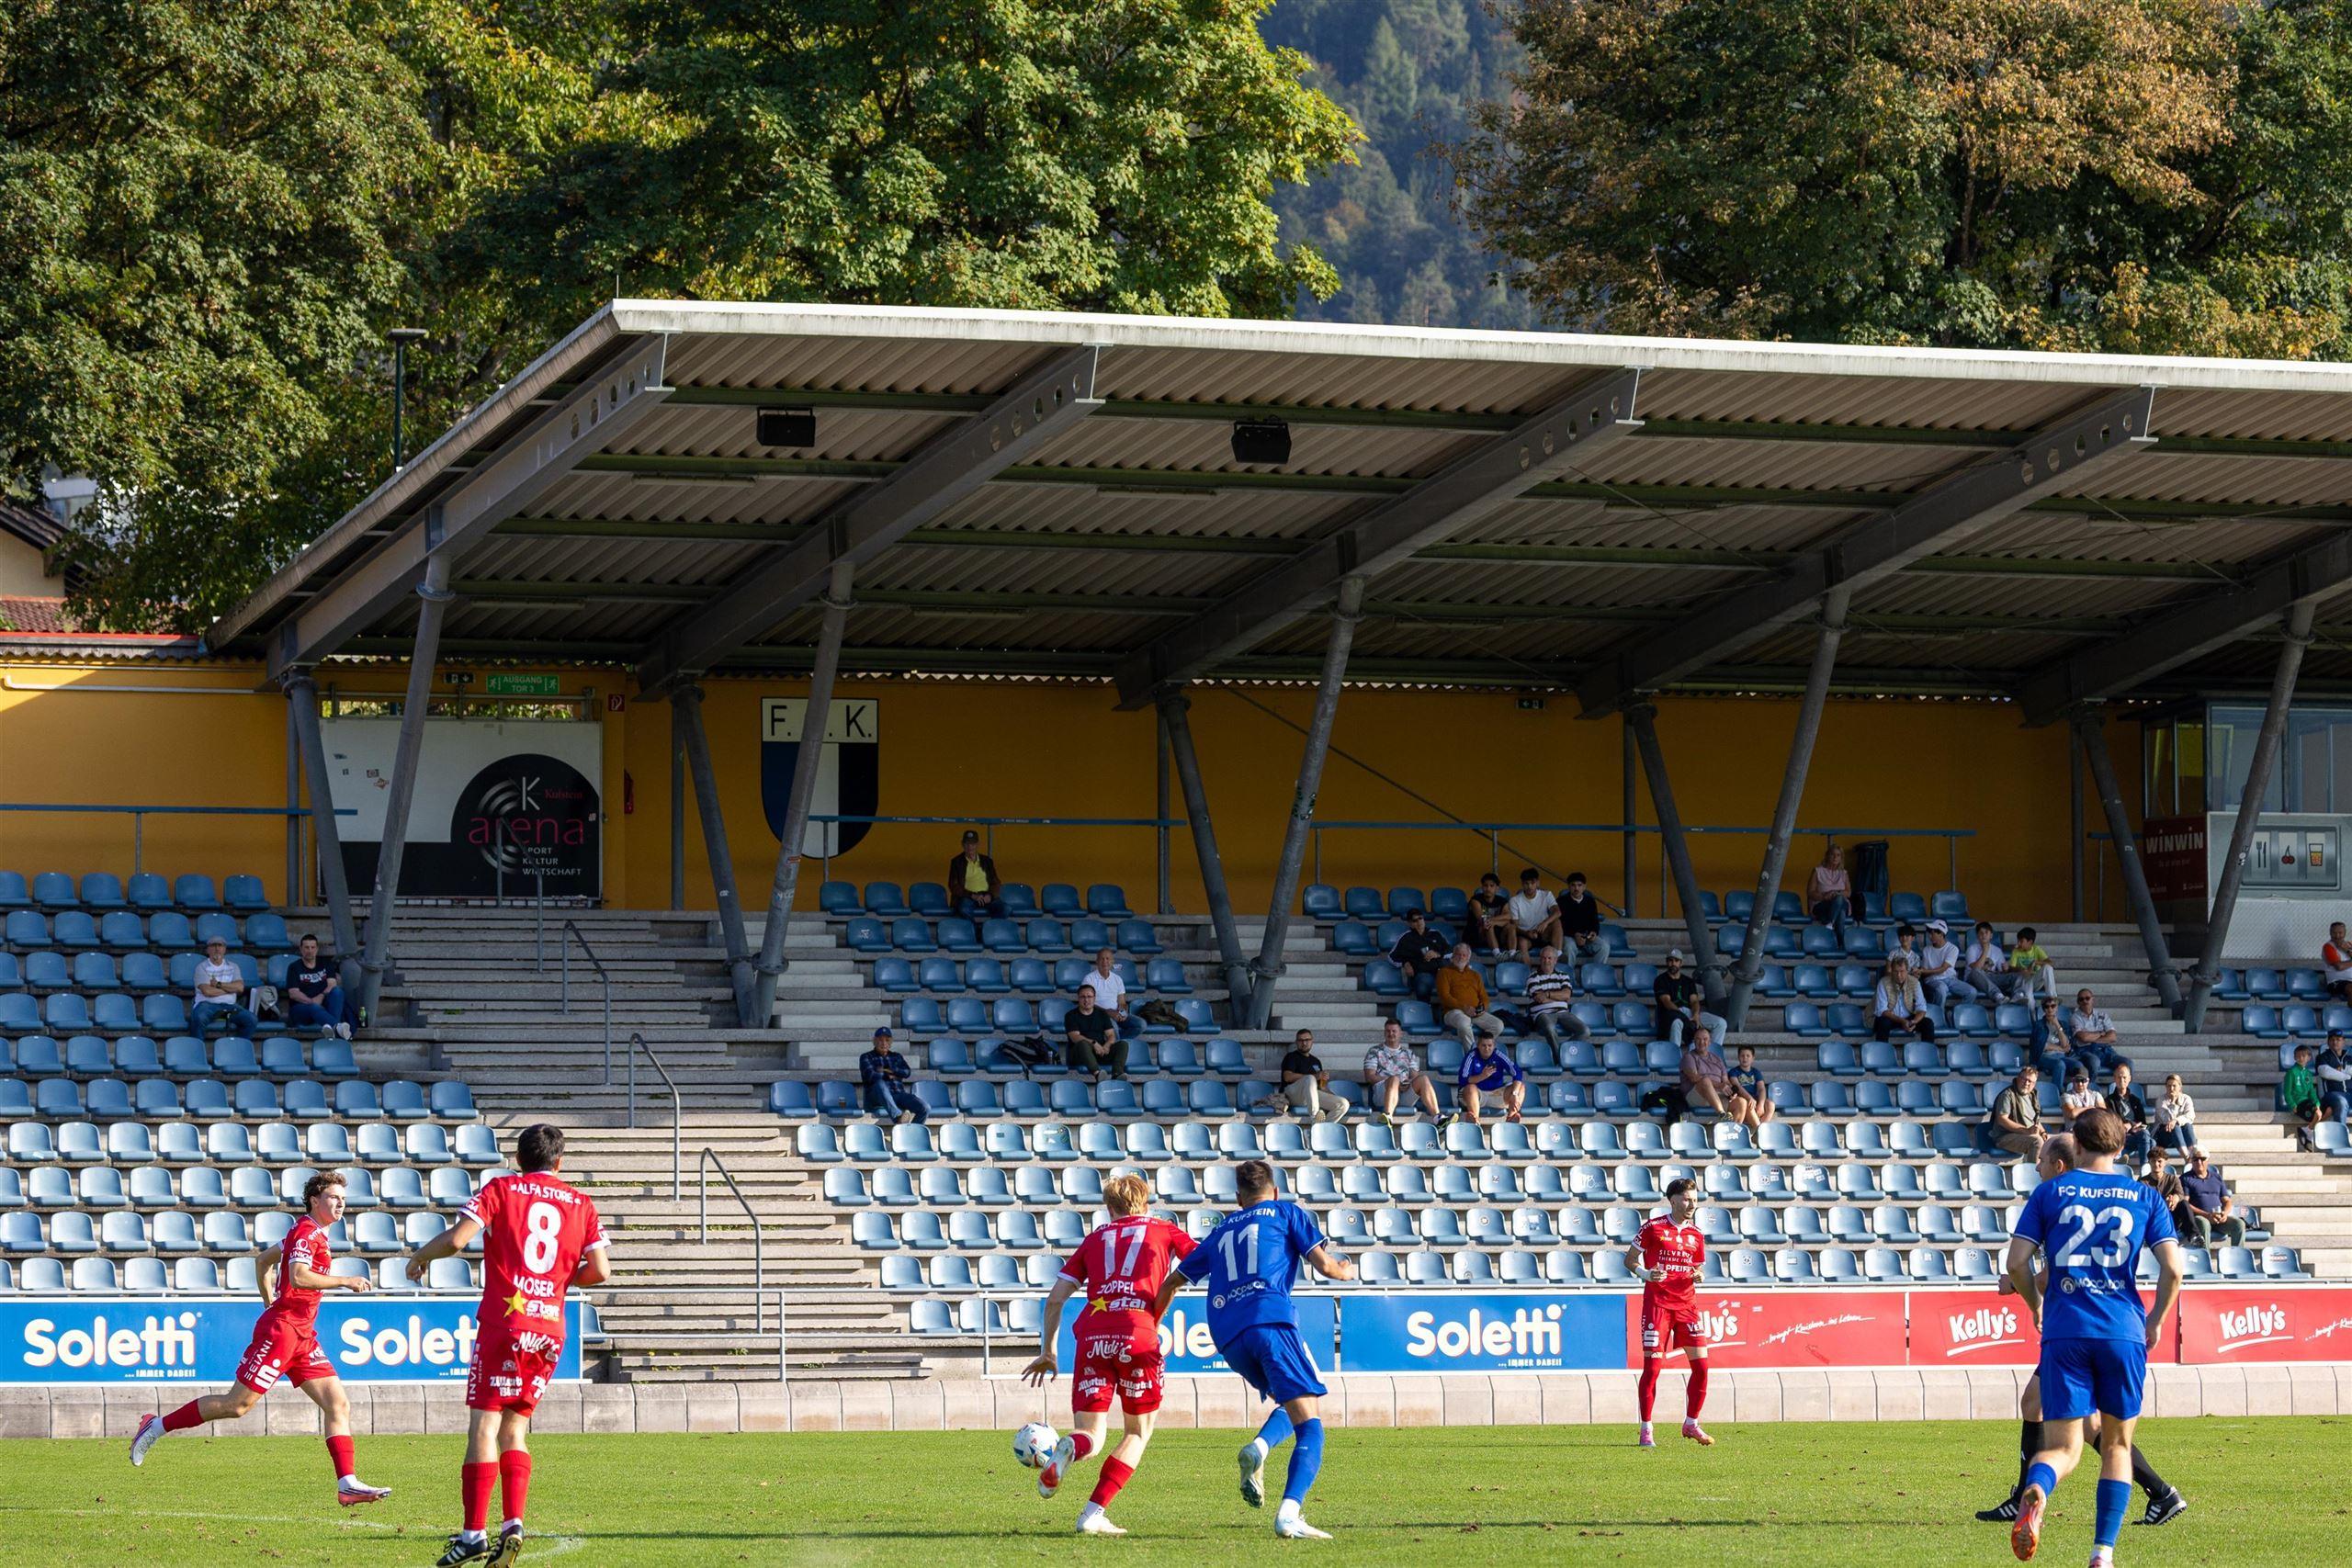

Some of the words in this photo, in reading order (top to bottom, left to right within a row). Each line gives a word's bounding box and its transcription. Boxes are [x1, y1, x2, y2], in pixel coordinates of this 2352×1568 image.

[517, 1182, 541, 1197] ALFA
[542, 1186, 574, 1204] STORE
[1227, 1207, 1275, 1224] KUFSTEIN
[2058, 1185, 2076, 1197] FC
[2079, 1186, 2139, 1201] KUFSTEIN
[524, 1201, 561, 1274] 8
[1102, 1224, 1148, 1280] 17
[1217, 1223, 1260, 1282] 11
[2055, 1204, 2134, 1268] 23
[513, 1274, 556, 1298] MOSER
[24, 1312, 196, 1367] Soletti
[339, 1315, 481, 1366] Solet
[1407, 1303, 1562, 1357] Soletti
[1949, 1306, 2018, 1343] Kelly's
[2219, 1303, 2286, 1340] Kelly's
